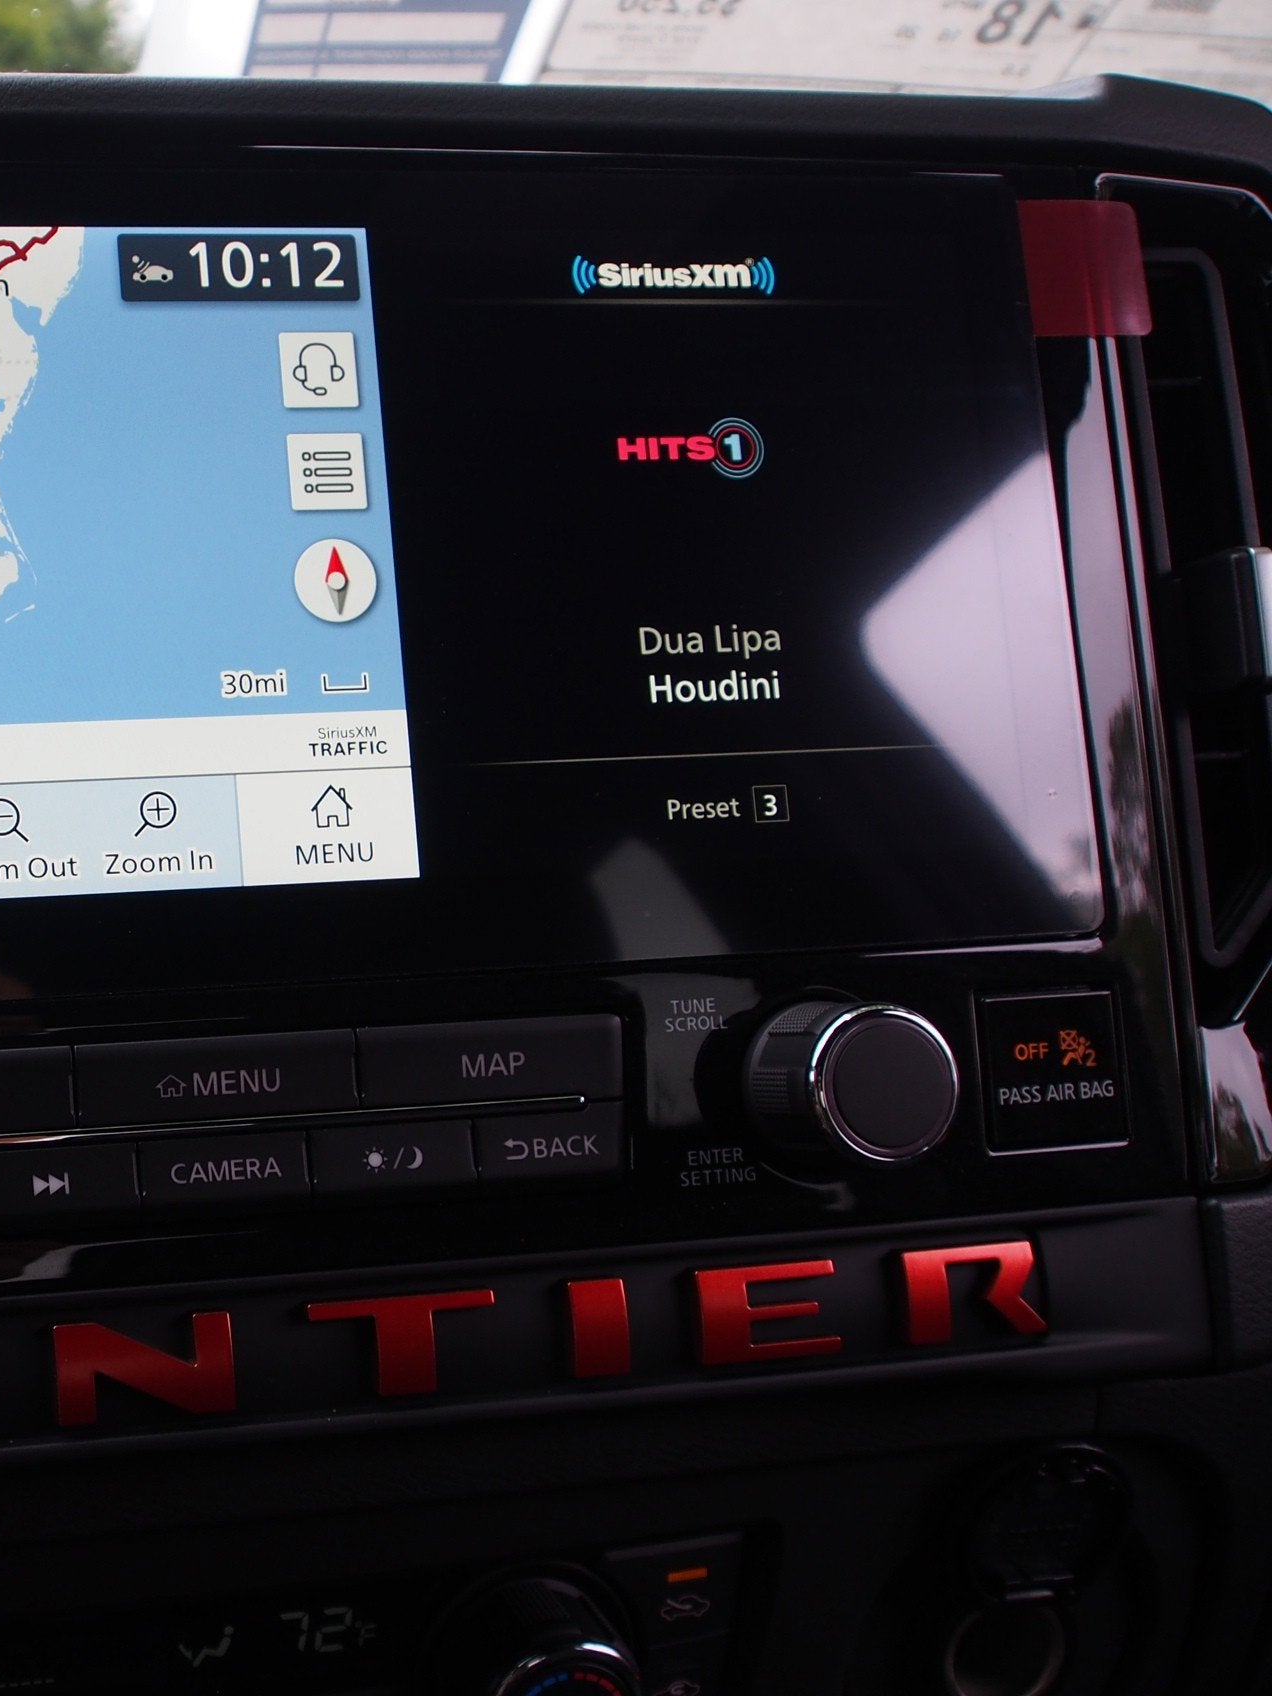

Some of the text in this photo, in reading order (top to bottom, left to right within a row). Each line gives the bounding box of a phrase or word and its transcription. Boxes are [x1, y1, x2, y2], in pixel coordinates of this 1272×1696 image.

[187, 242, 345, 289] 10:12
[616, 434, 715, 462] HITS
[638, 623, 782, 660] Dua Lipa
[222, 672, 285, 696] 30mi
[648, 670, 781, 704] Houdini
[318, 726, 378, 740] SiriusXM
[309, 740, 388, 757] TRAFFIC
[666, 794, 779, 820] Preset 3
[105, 850, 213, 875] Zoom In
[296, 841, 375, 866] MENU
[28, 857, 78, 880] Out
[670, 997, 716, 1014] TUNE
[665, 1014, 729, 1033] SCROLL
[1014, 1042, 1049, 1062] OFF
[460, 1051, 527, 1079] MAP
[192, 1068, 282, 1097] MENU
[999, 1079, 1115, 1106] PASS AIR BAG
[532, 1133, 600, 1161] BACK
[687, 1147, 744, 1167] ENTER
[170, 1156, 283, 1185] CAMERA
[679, 1166, 759, 1188] SETTING
